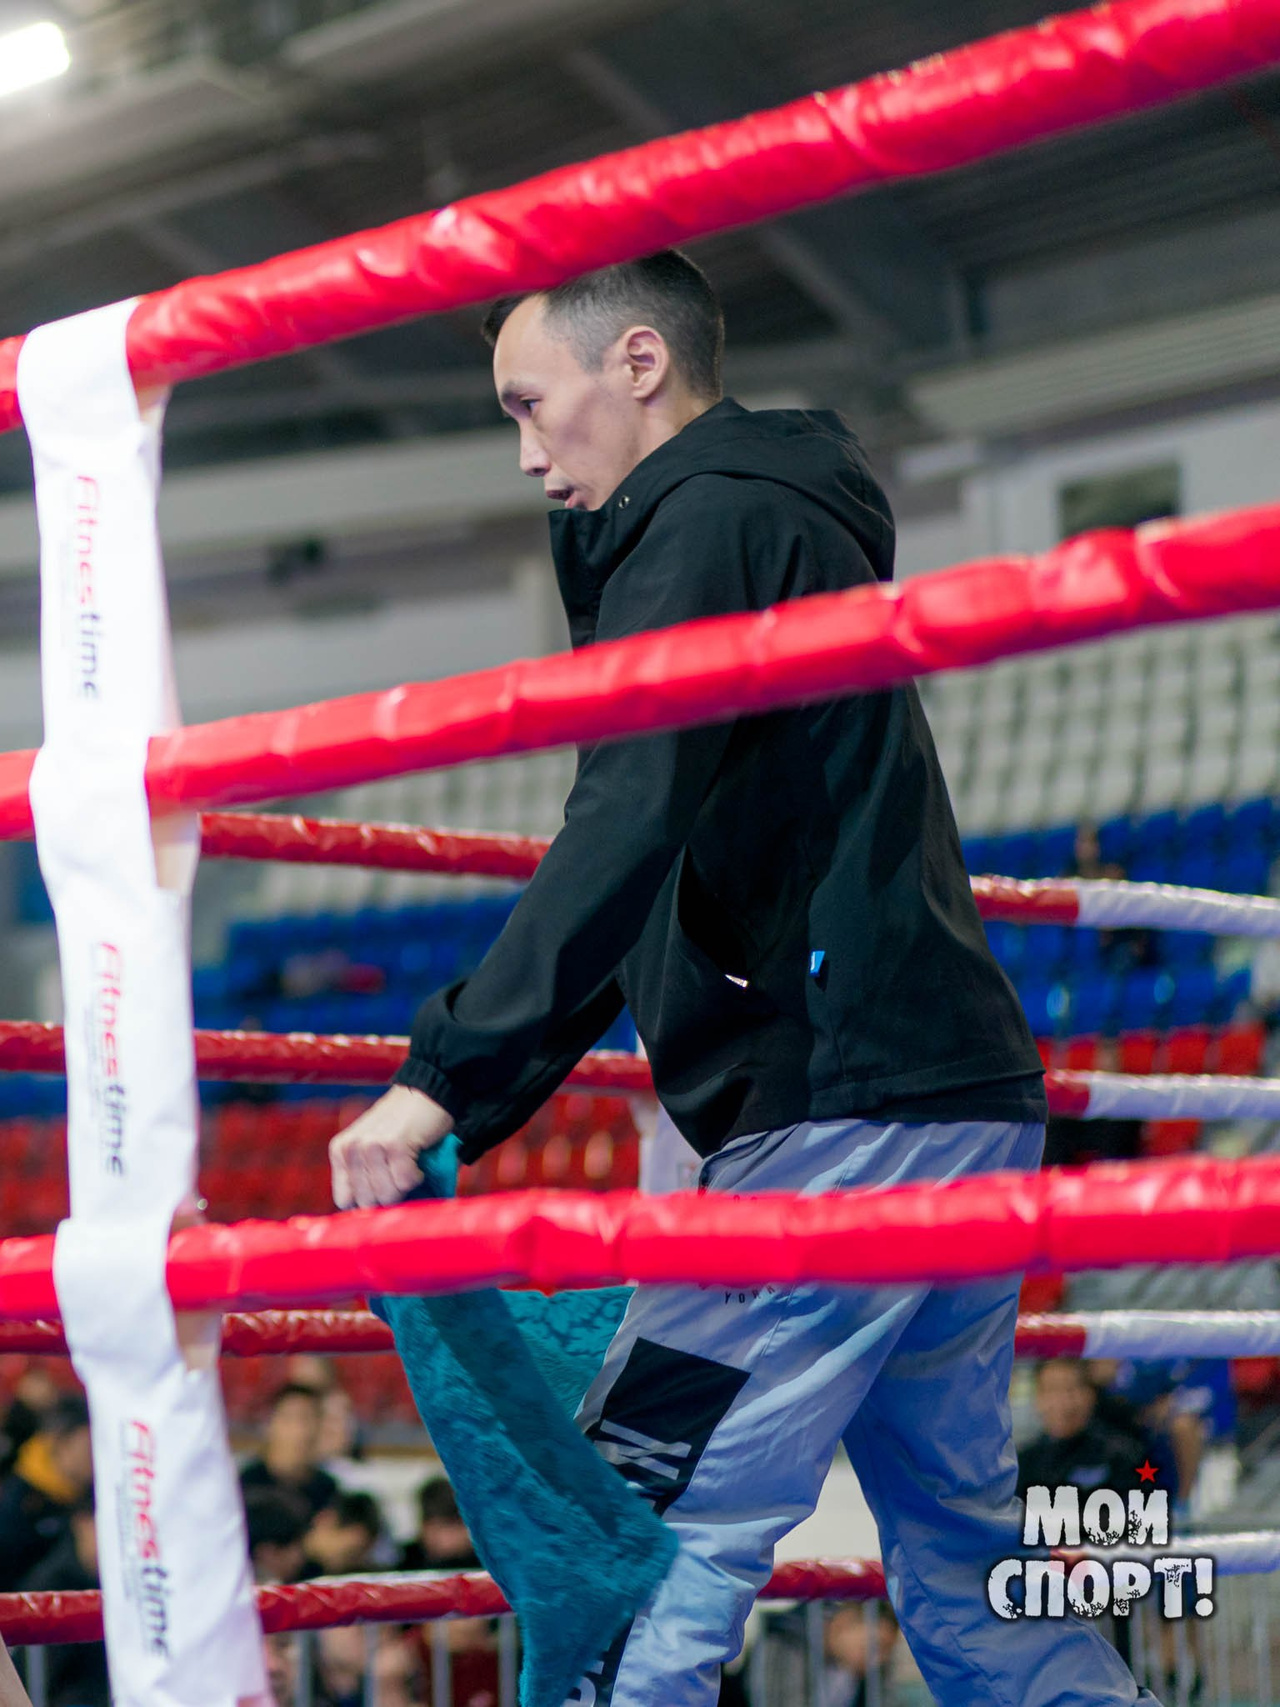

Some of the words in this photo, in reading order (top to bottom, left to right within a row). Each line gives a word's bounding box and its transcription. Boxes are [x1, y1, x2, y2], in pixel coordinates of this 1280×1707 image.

[77, 474, 103, 700] Fitnestime
[99, 941, 127, 1176] Fitnestime
[131, 1419, 170, 1655] Fitnestime
